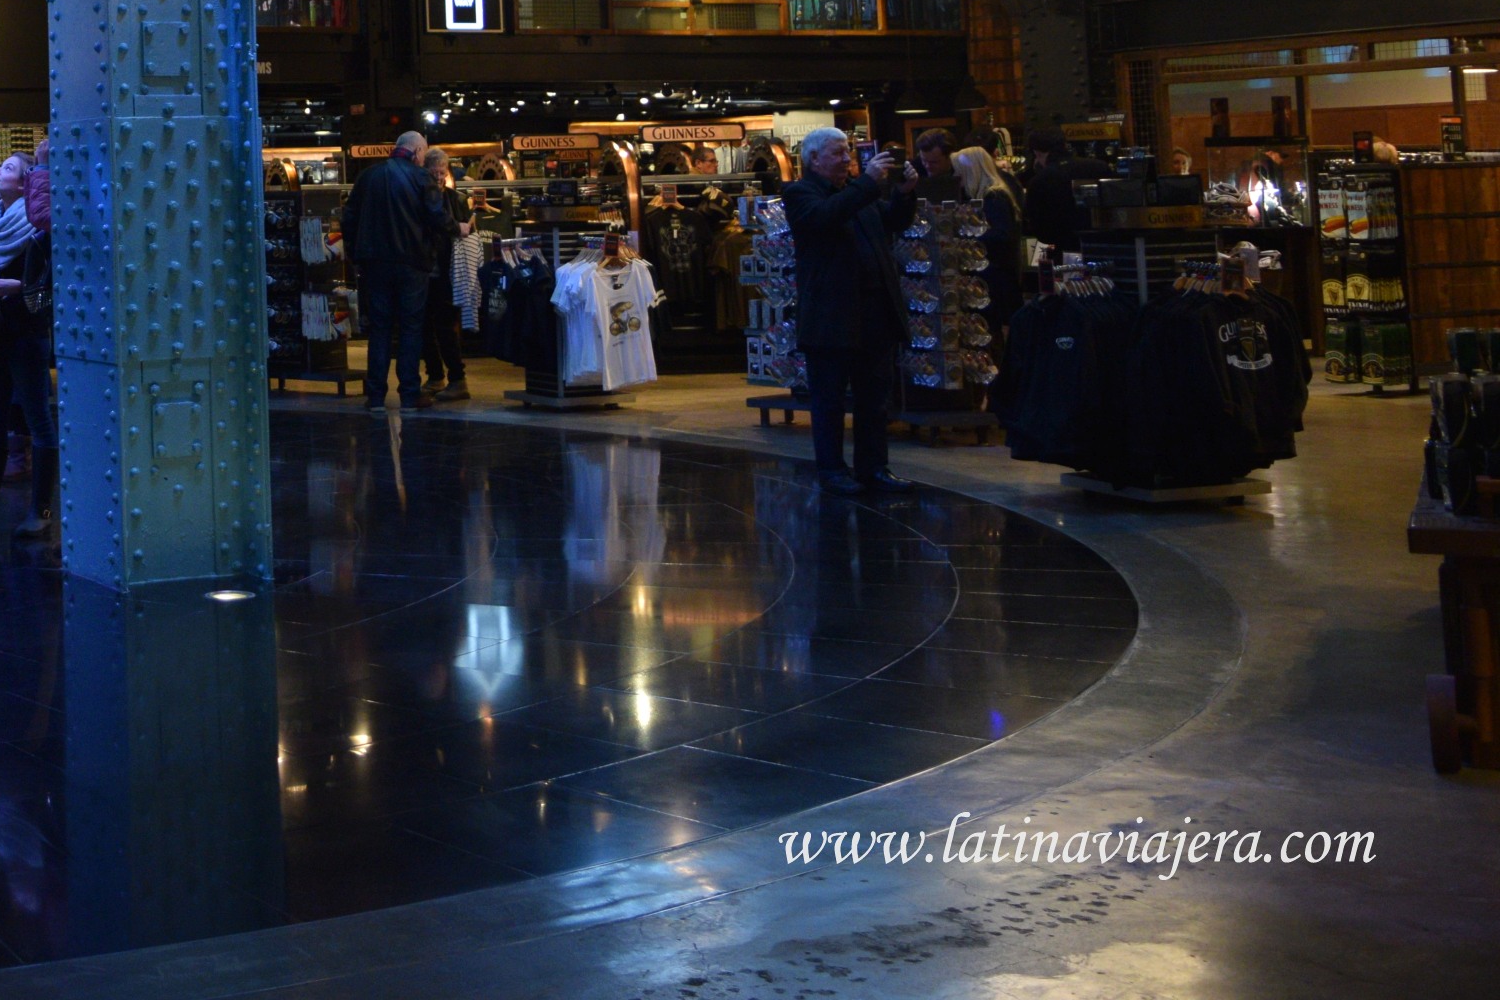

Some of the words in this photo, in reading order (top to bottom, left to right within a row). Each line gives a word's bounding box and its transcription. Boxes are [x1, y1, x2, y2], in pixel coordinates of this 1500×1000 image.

[256, 60, 273, 75] MS
[652, 126, 716, 140] GUINNESS
[520, 136, 576, 148] GUINNESS
